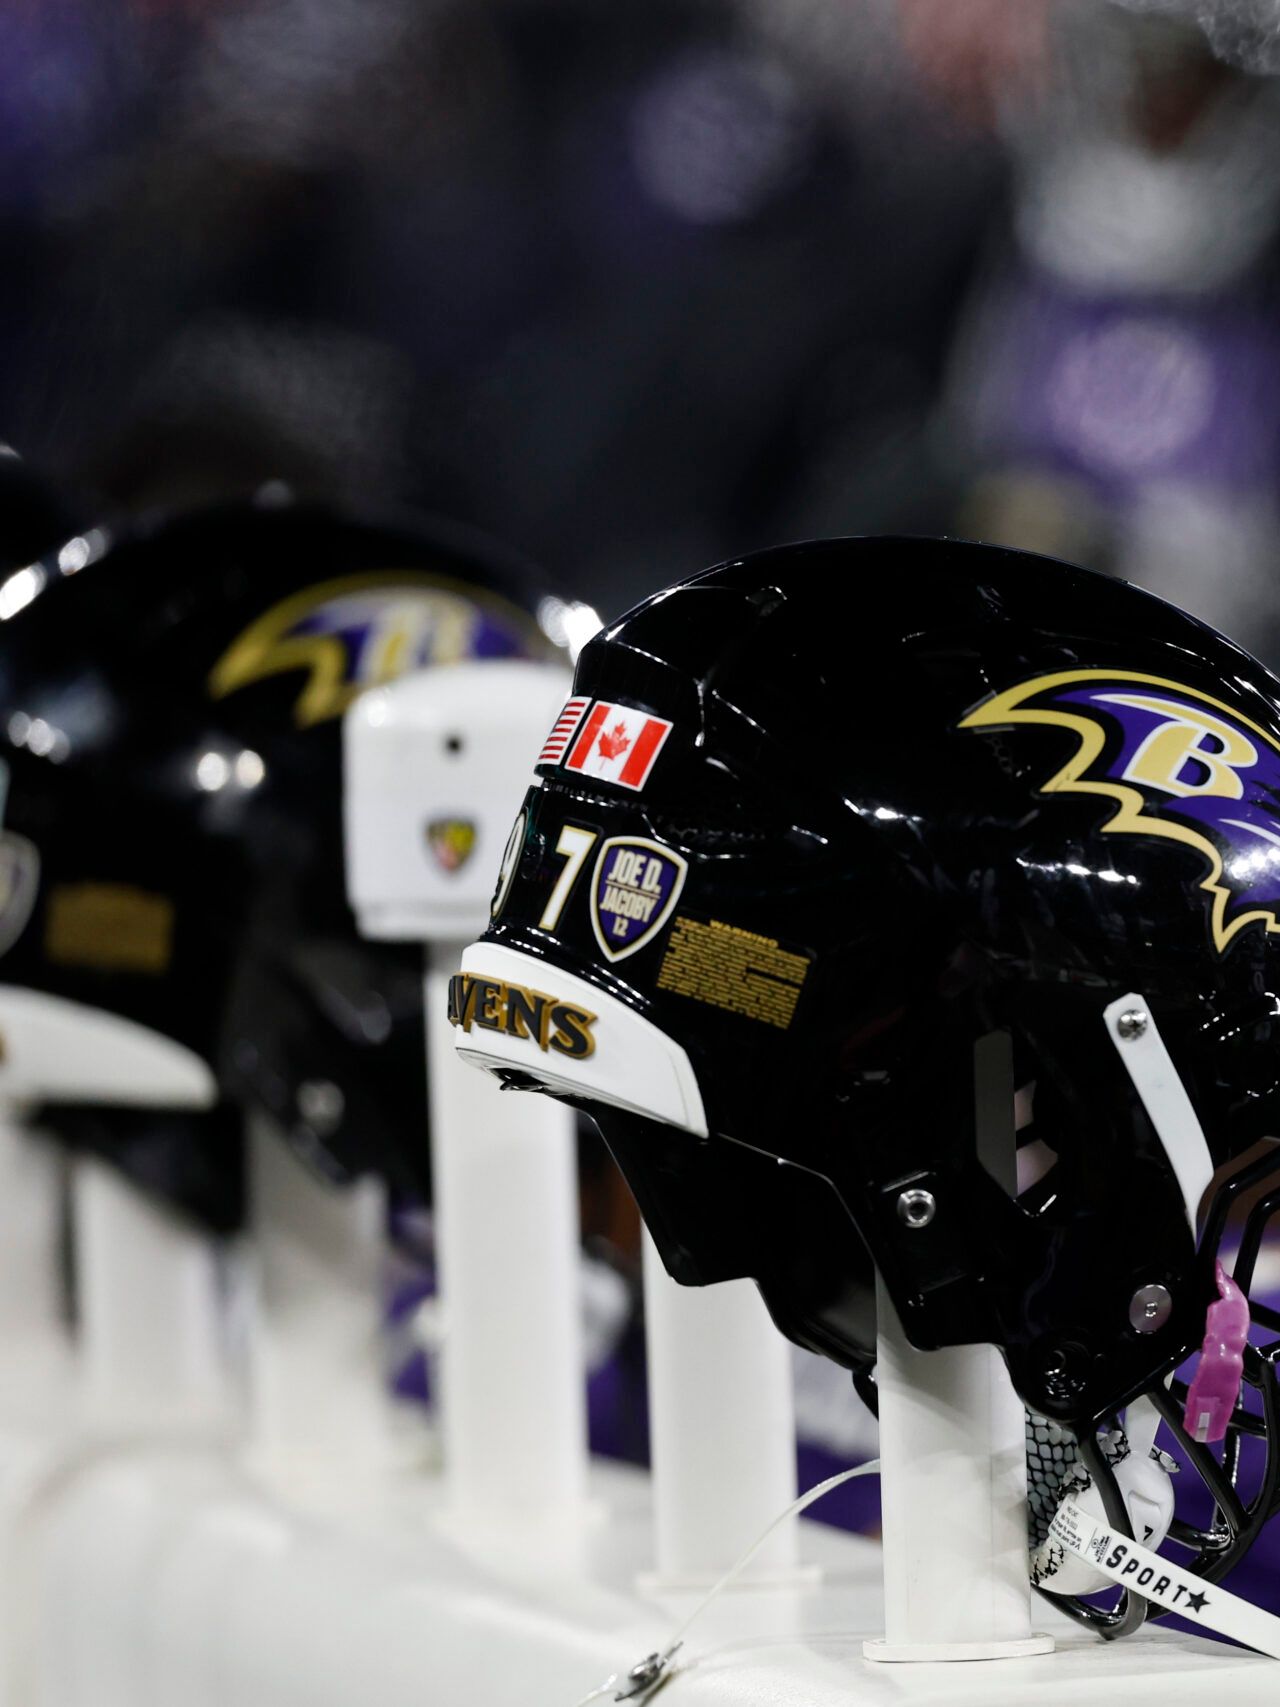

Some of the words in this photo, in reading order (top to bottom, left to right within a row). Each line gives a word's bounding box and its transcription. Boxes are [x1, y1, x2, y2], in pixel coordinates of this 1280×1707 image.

[1118, 704, 1258, 800] B
[607, 848, 647, 887] JOE
[641, 857, 663, 894] D.
[600, 886, 658, 923] JACOBY
[612, 916, 629, 937] 12
[709, 919, 779, 949] WARNING
[448, 971, 598, 1060] VENS
[1106, 1545, 1188, 1603] SPORT
